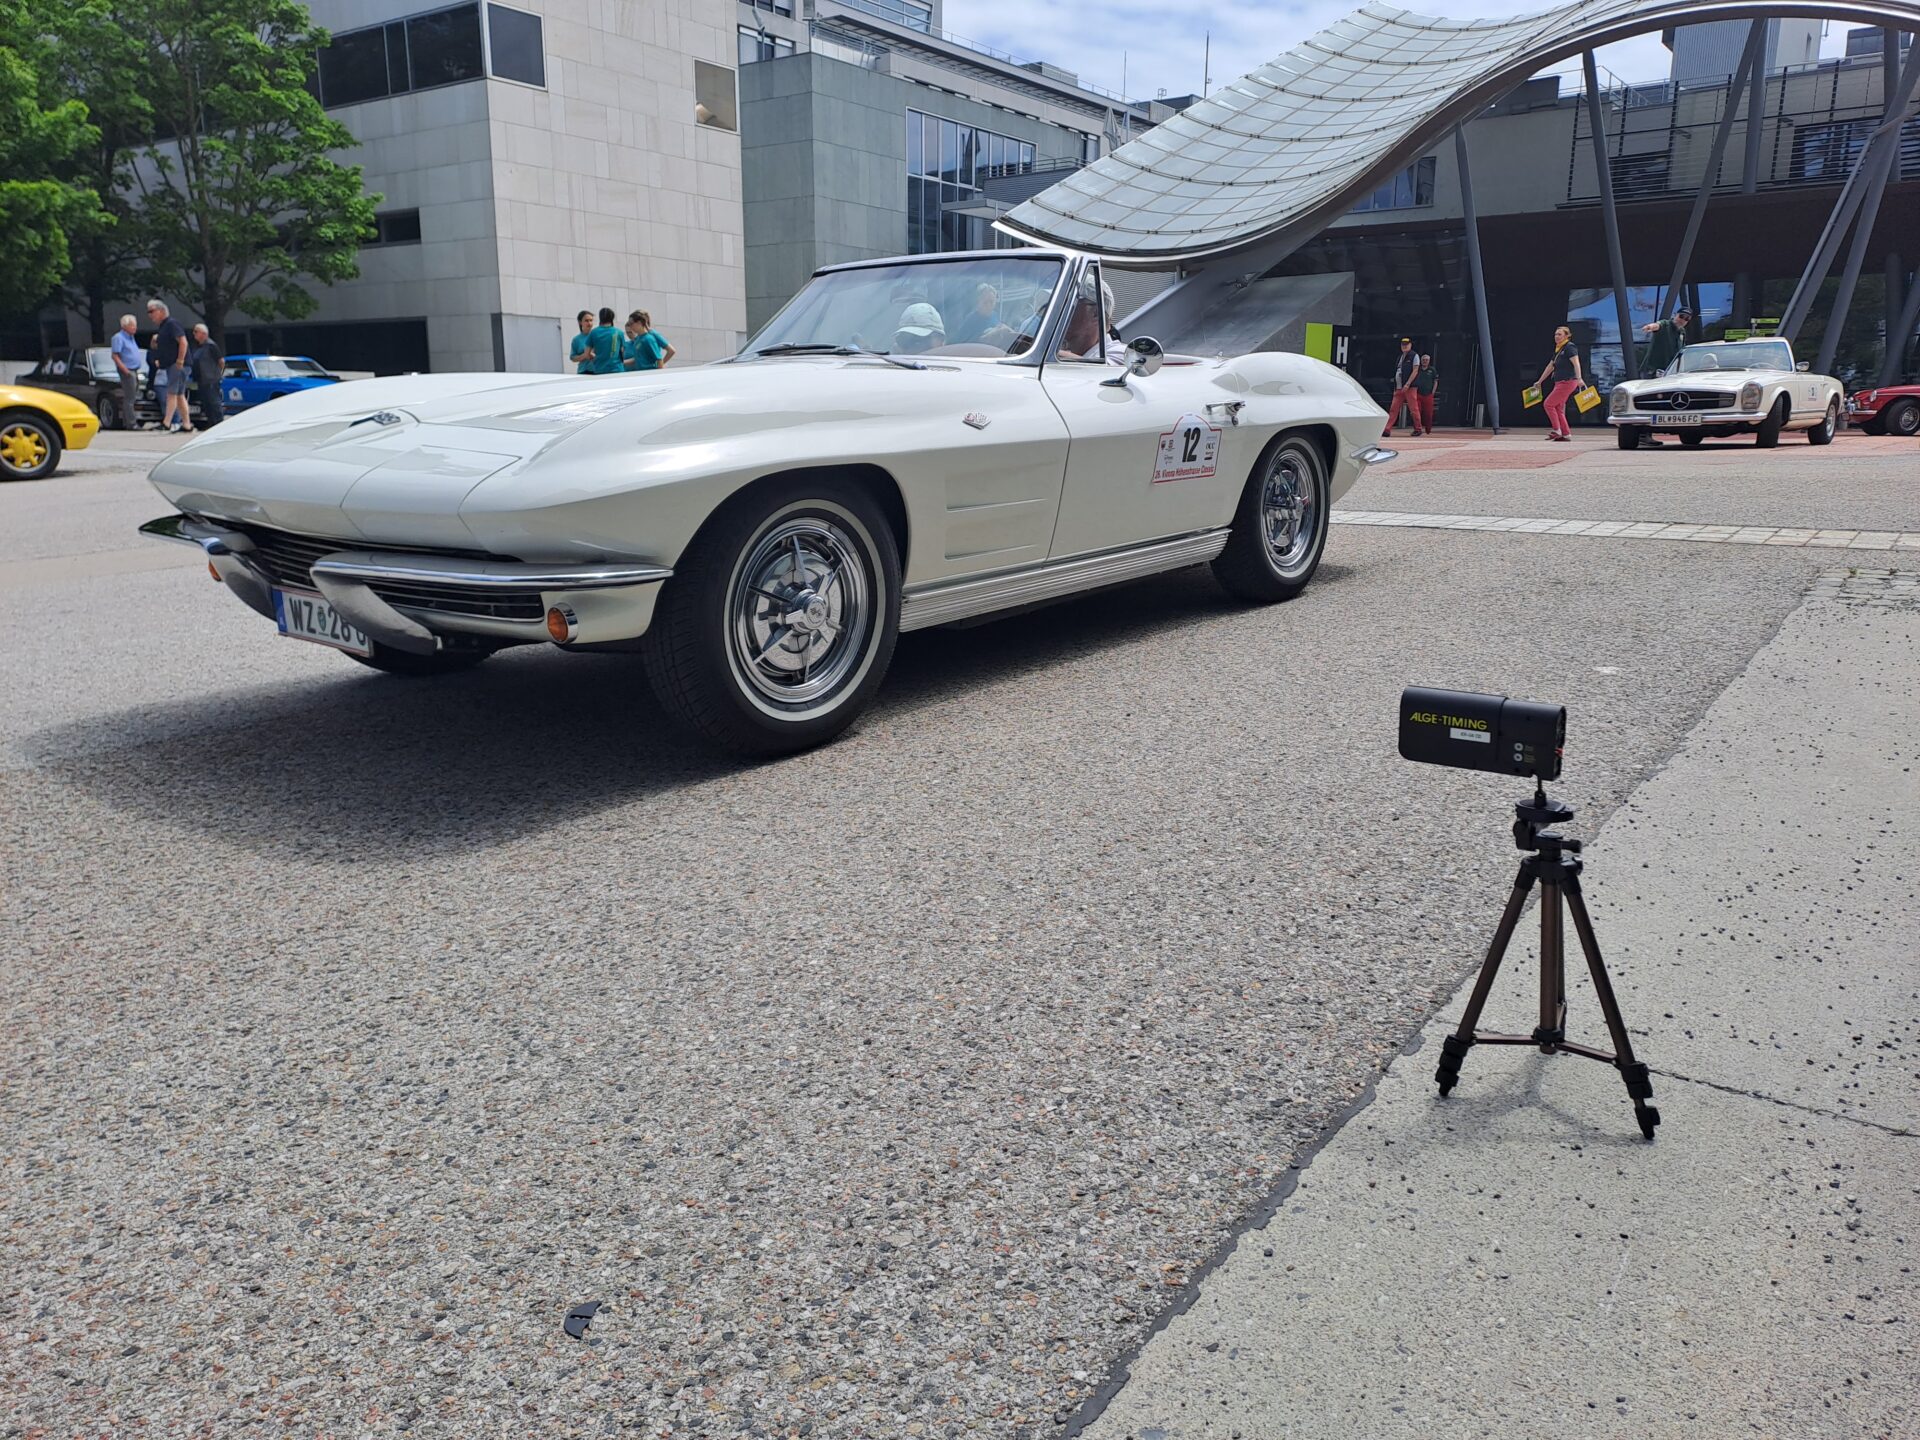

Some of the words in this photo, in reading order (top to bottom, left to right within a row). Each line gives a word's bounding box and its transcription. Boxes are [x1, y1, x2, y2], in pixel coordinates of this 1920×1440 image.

[1658, 415, 1667, 423] BL
[1182, 427, 1201, 463] 12
[289, 597, 317, 634] WZ
[1409, 711, 1488, 731] ALGE-TIMING
